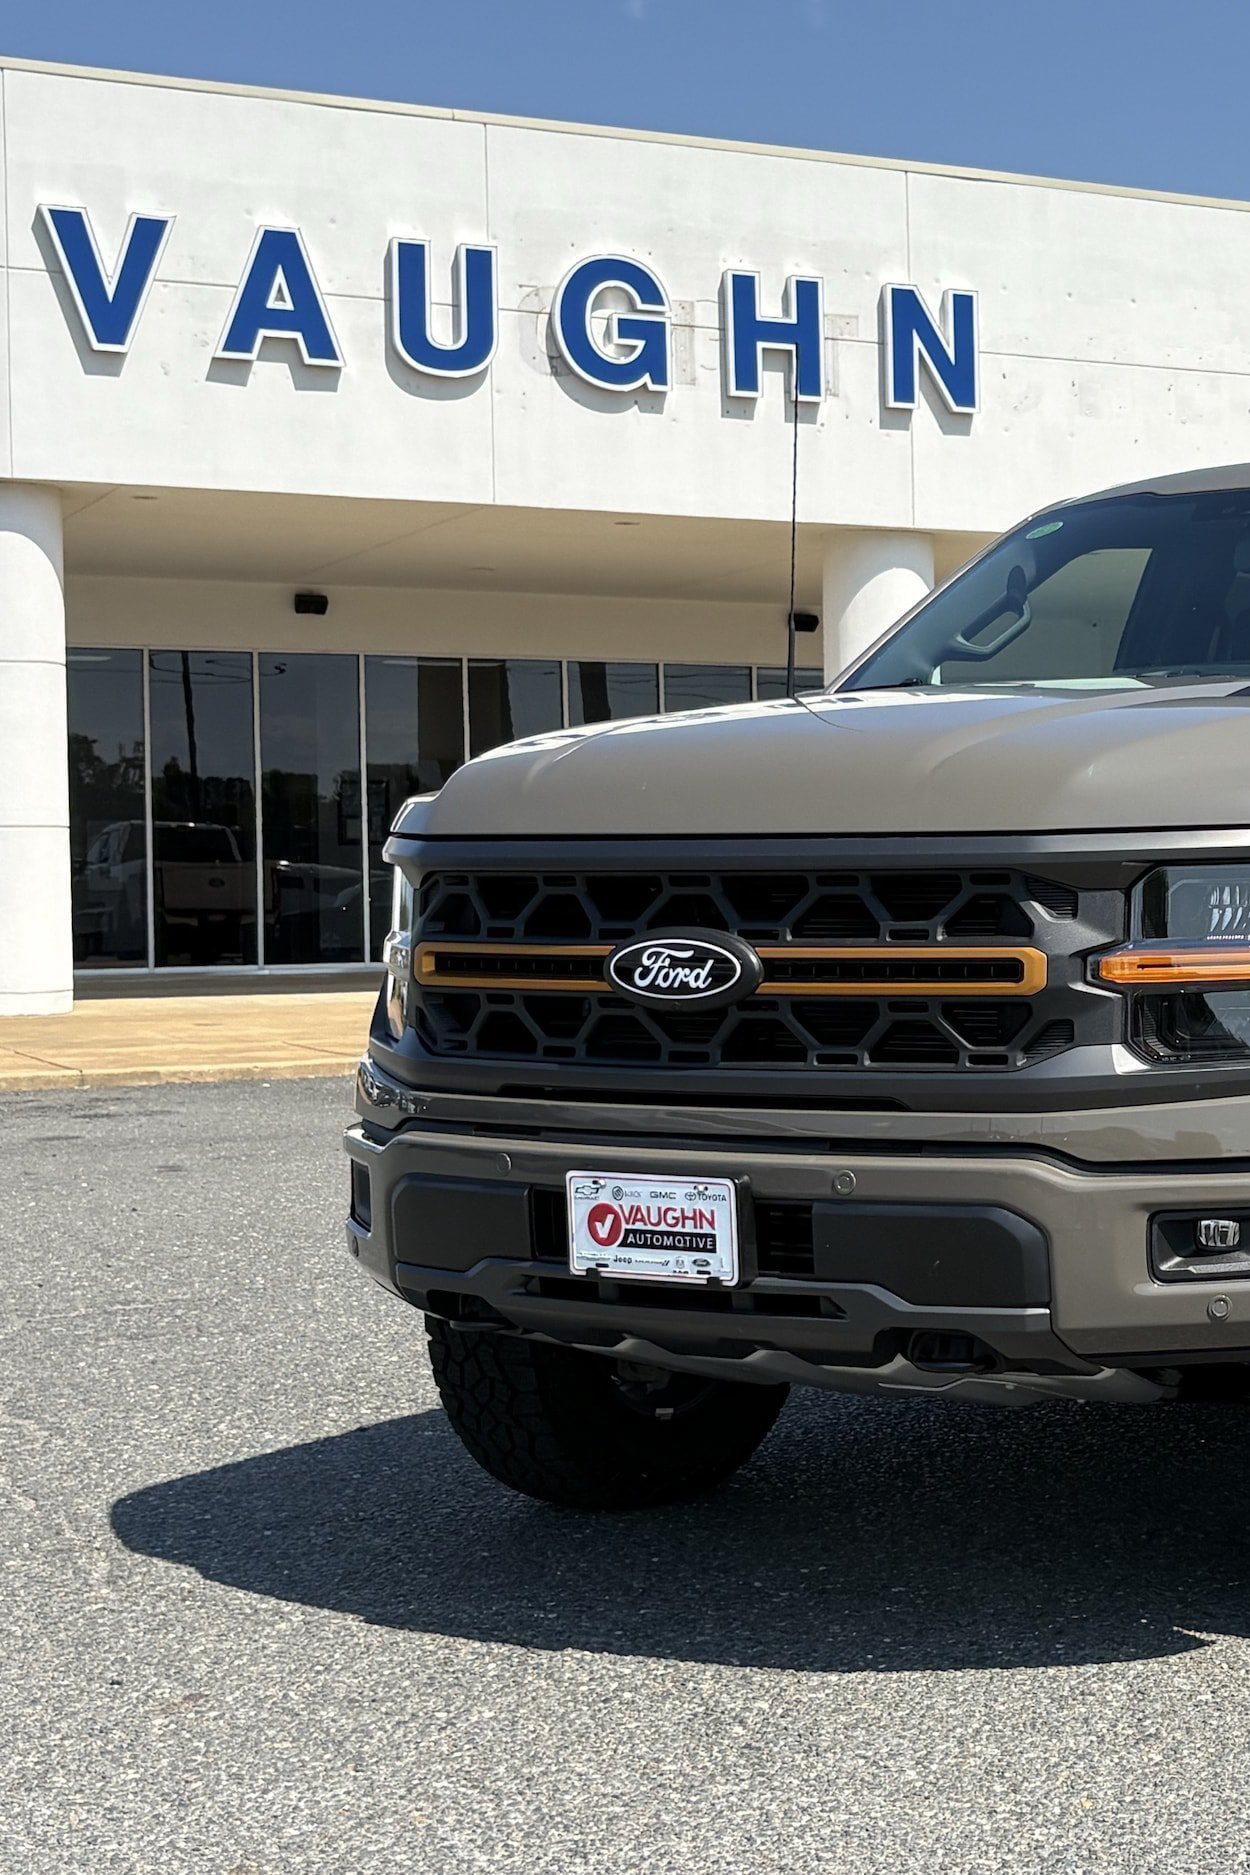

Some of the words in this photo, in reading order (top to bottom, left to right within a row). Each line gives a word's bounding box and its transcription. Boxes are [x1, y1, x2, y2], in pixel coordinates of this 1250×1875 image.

[36, 204, 980, 415] VAUGHN
[633, 947, 715, 989] Ford
[649, 1190, 677, 1200] GMC
[697, 1190, 727, 1202] TOYOTA
[618, 1203, 716, 1231] VAUGHN
[626, 1232, 714, 1250] AUTOMOTIVE
[613, 1254, 633, 1265] Jeep
